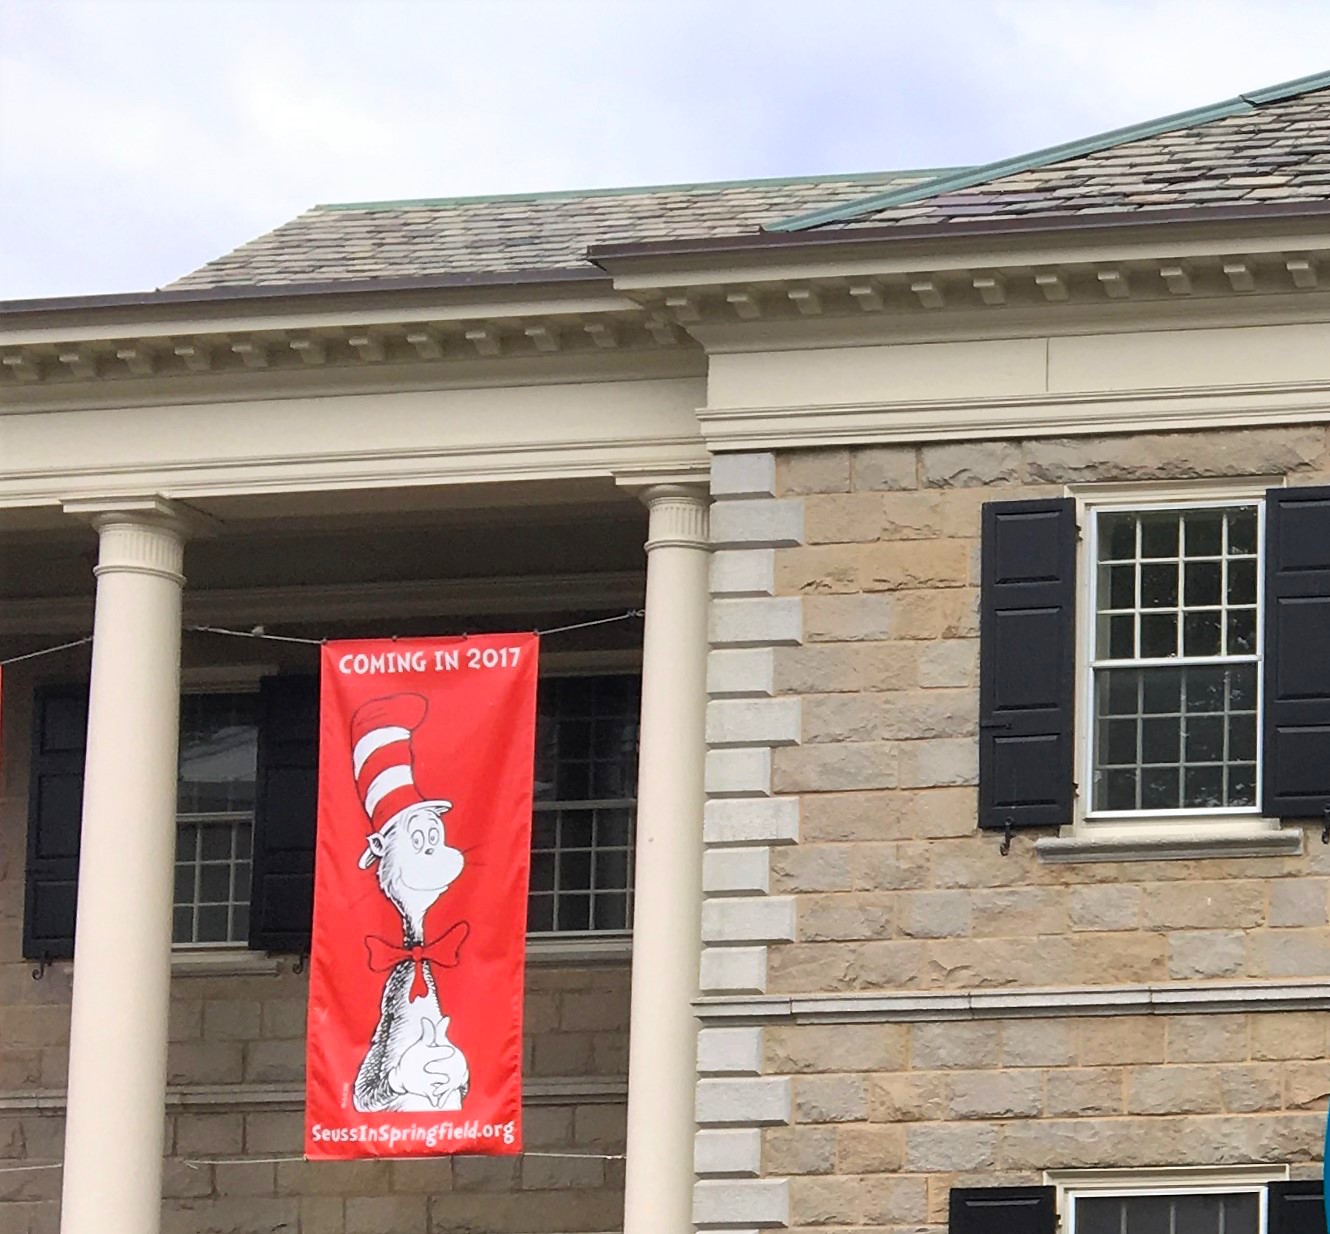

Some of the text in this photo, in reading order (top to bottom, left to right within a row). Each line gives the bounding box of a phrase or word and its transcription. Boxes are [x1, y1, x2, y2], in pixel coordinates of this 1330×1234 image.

[338, 647, 521, 675] COMING IN 2017
[311, 1120, 515, 1147] SeussInSpringfield.org
